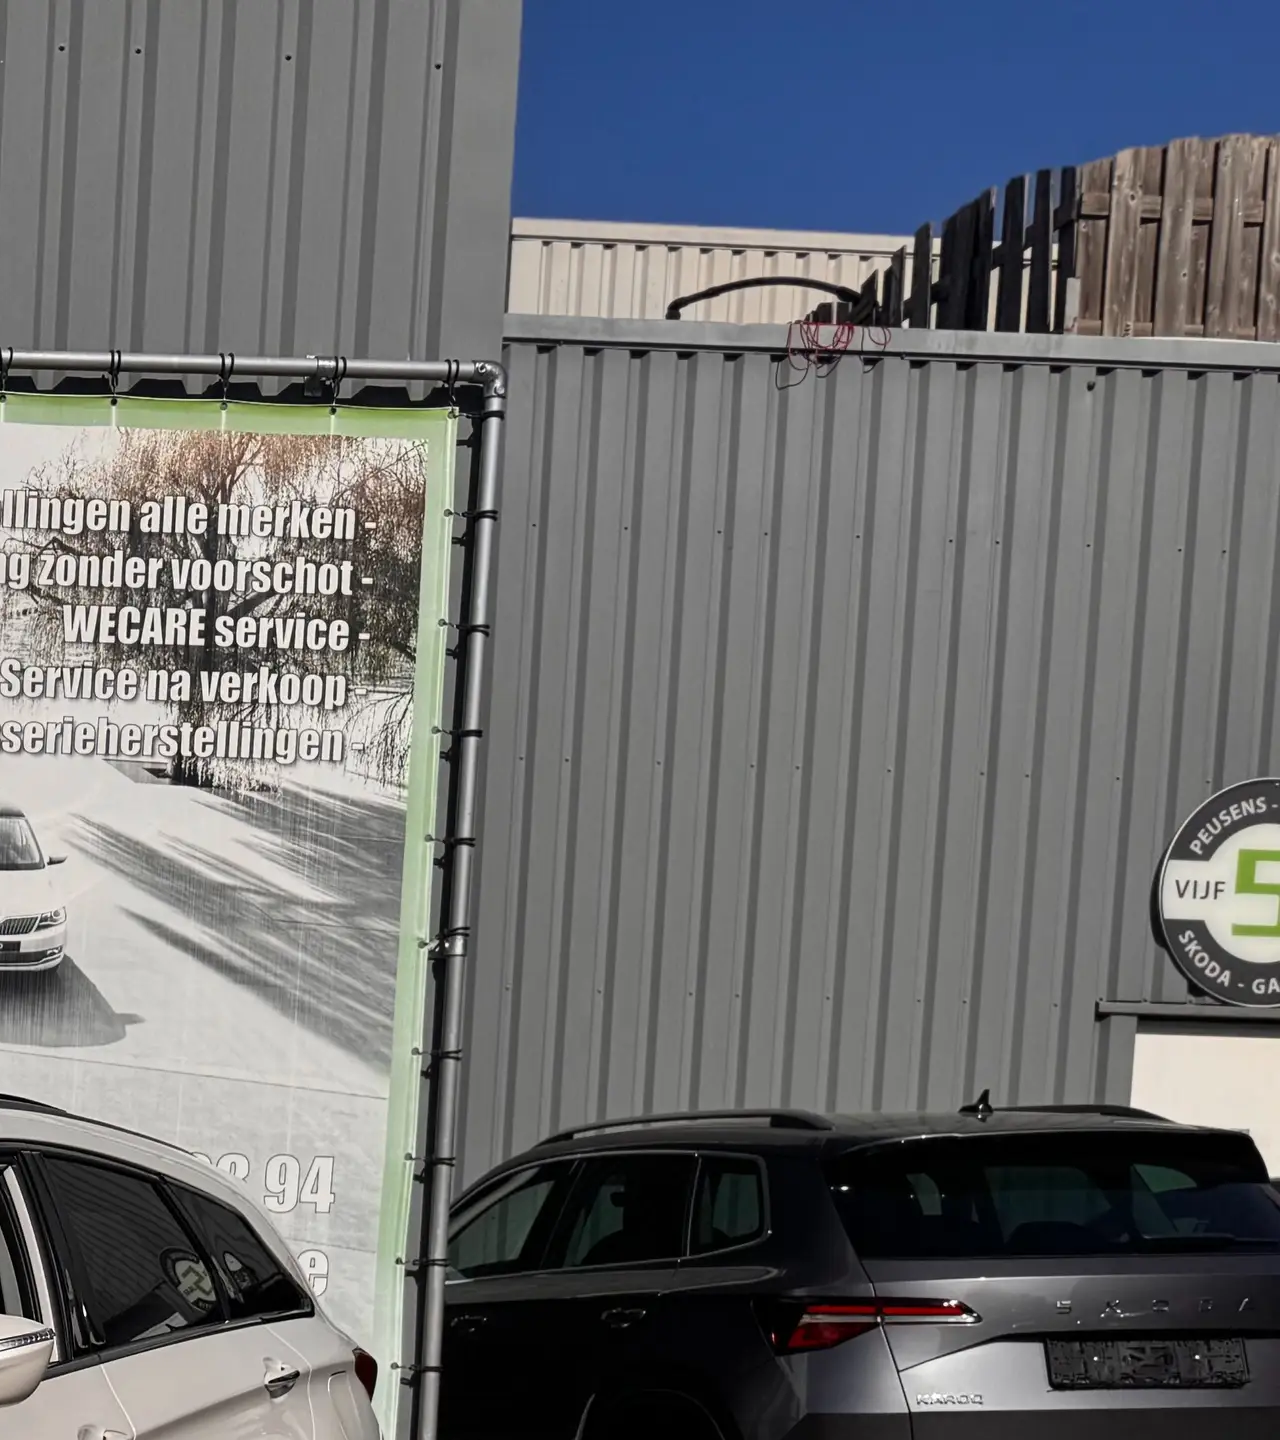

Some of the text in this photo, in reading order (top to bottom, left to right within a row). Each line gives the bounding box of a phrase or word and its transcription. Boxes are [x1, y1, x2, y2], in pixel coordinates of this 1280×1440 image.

[140, 495, 208, 535] alle
[217, 501, 356, 540] merken
[38, 549, 163, 590] zonder
[170, 557, 354, 596] voorschot
[61, 605, 207, 646] WECARE
[214, 611, 350, 652] service
[144, 667, 188, 702] na
[199, 666, 346, 709] verkoop
[1189, 796, 1268, 856] PEUSENS
[1174, 879, 1227, 901] VIJF
[1178, 929, 1232, 988] SKODA
[263, 1153, 336, 1214] 94
[915, 1392, 984, 1406] KAROQ
